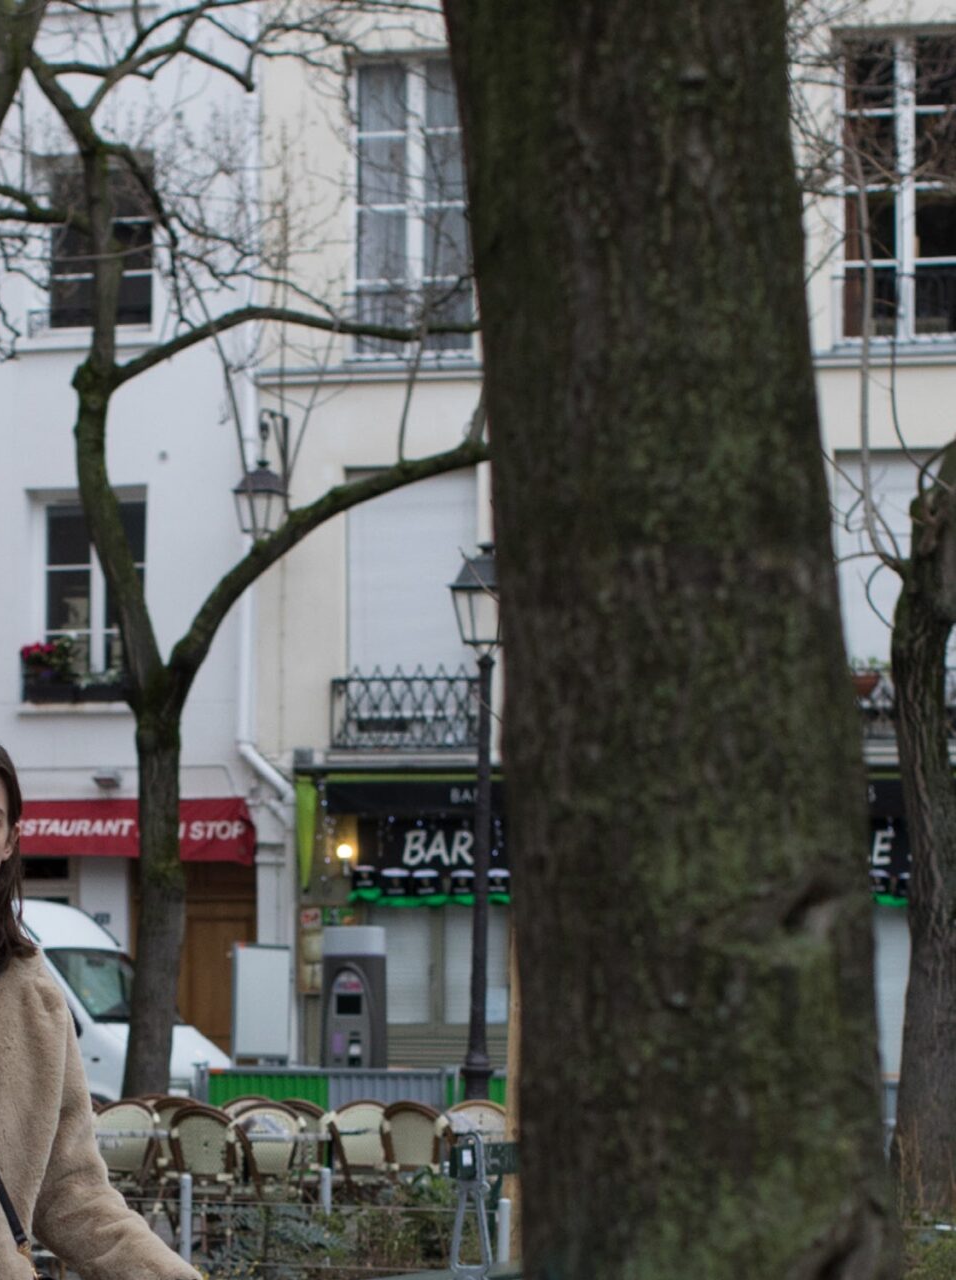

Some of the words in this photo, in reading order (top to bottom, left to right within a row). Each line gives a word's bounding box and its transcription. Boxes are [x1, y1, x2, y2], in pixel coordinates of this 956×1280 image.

[19, 818, 134, 837] STAURANT
[190, 820, 245, 840] STOP
[402, 829, 474, 866] BAR
